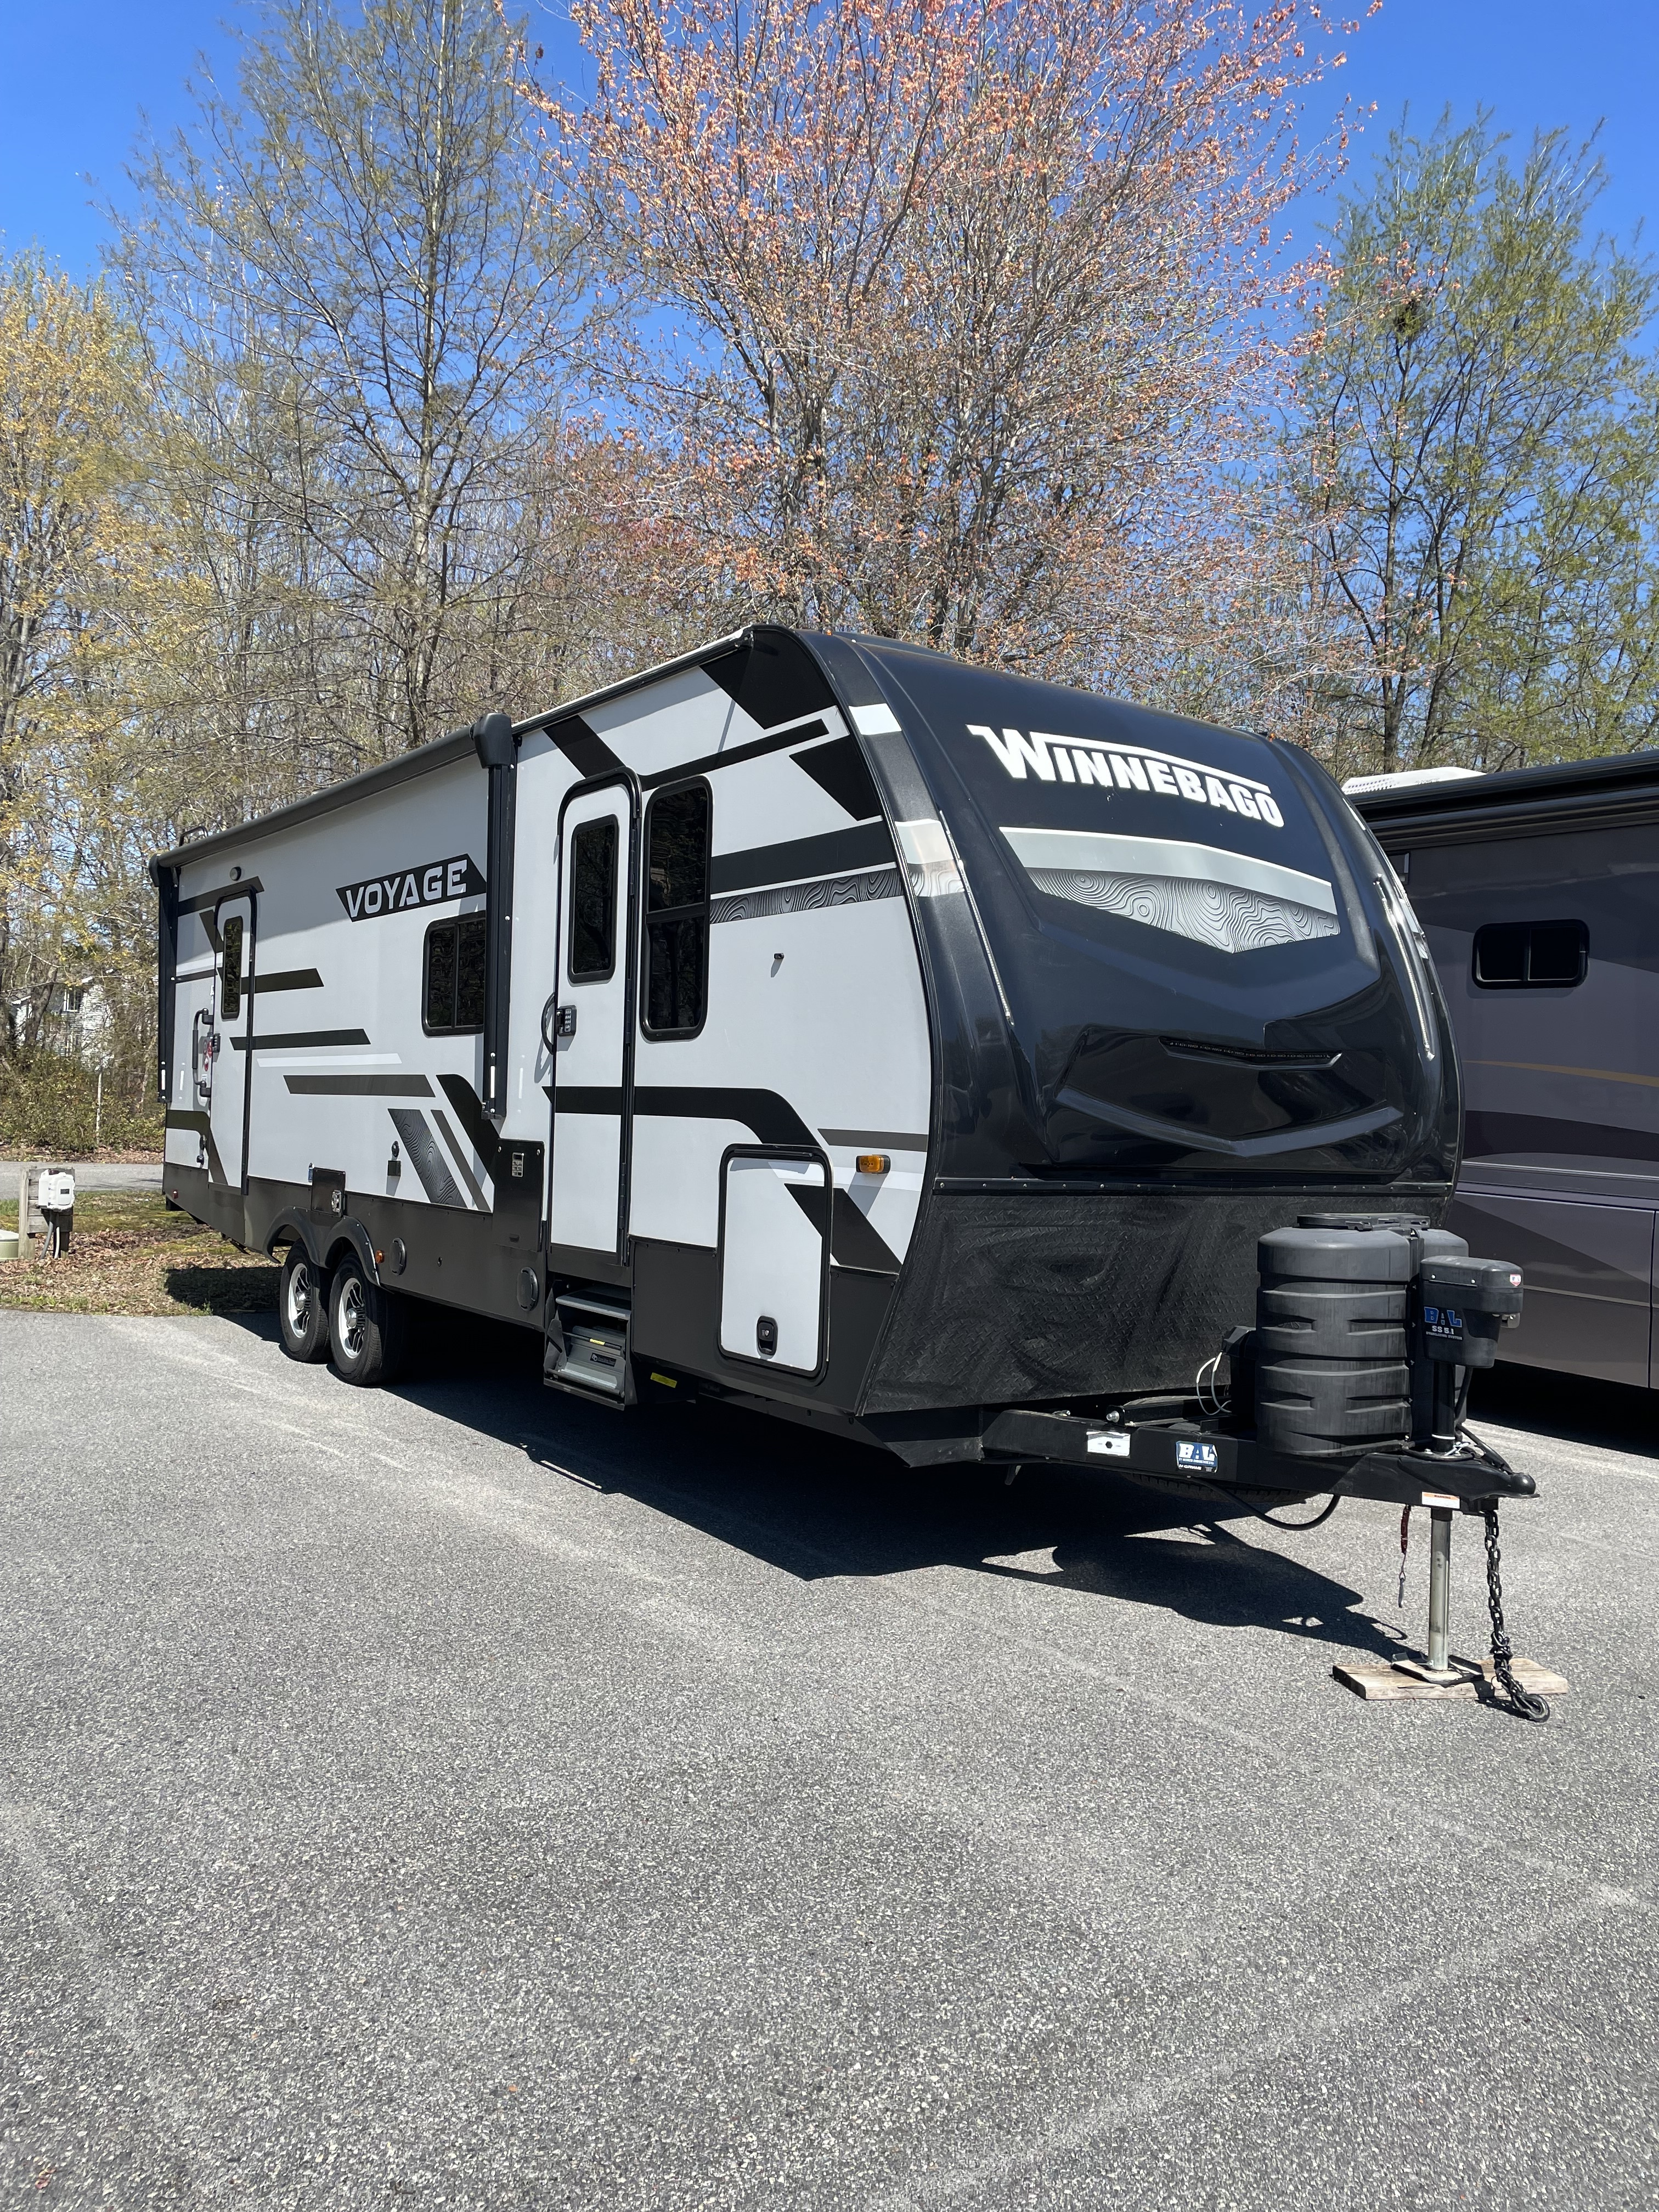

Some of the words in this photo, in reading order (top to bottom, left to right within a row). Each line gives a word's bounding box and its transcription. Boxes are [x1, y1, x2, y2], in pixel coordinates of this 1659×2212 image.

[965, 724, 1285, 827] WINNEBAGO
[346, 859, 467, 917] VOYAGE
[1424, 1306, 1463, 1328] BAL
[1178, 1443, 1215, 1462] BAL
